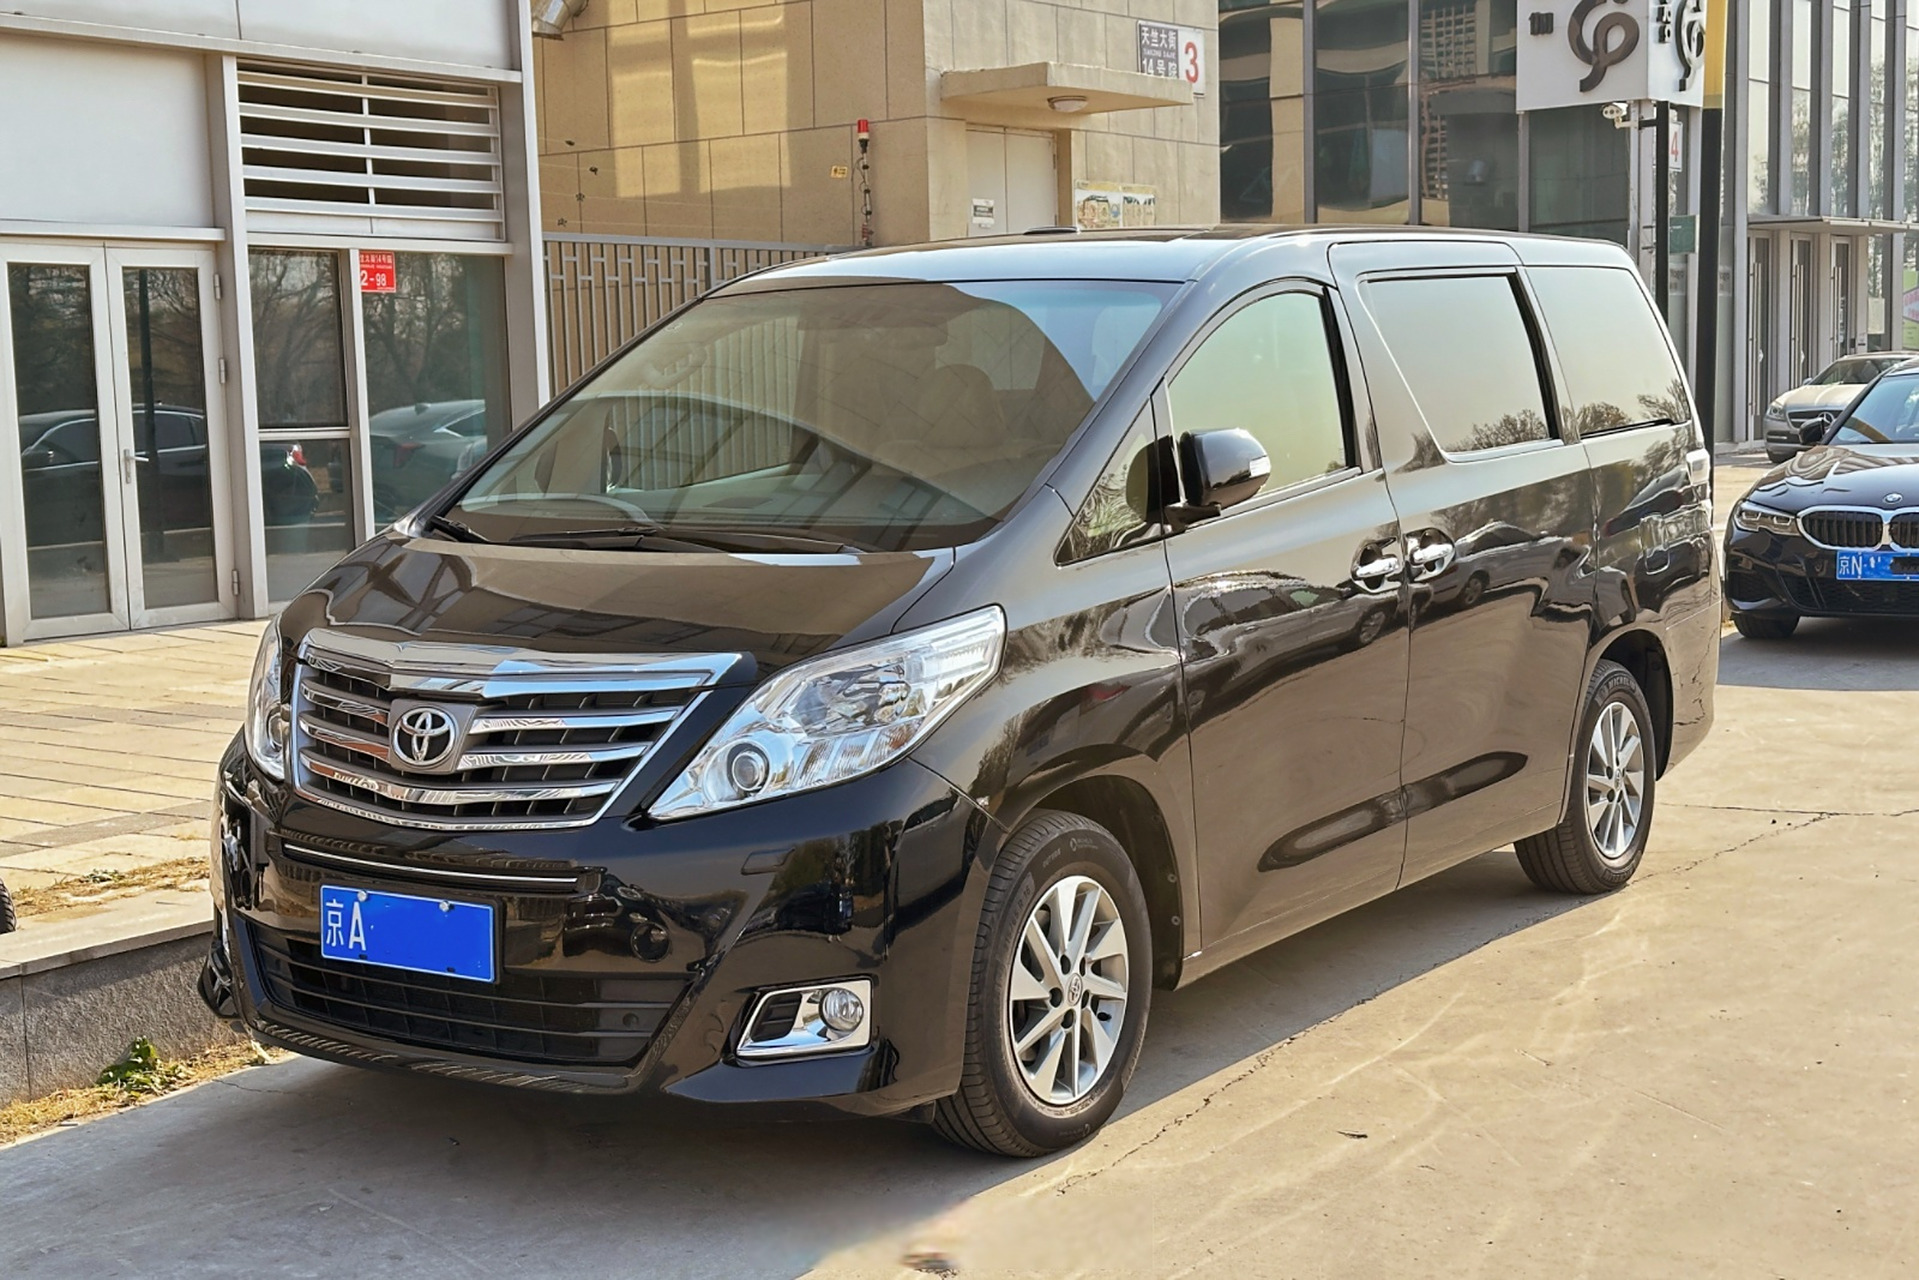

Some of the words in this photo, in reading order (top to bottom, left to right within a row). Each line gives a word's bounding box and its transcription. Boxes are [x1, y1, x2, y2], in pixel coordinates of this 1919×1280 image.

[1141, 27, 1176, 50] 天竺大街
[1185, 41, 1199, 84] 3
[1670, 131, 1679, 162] 4
[325, 898, 367, 951] 京A
